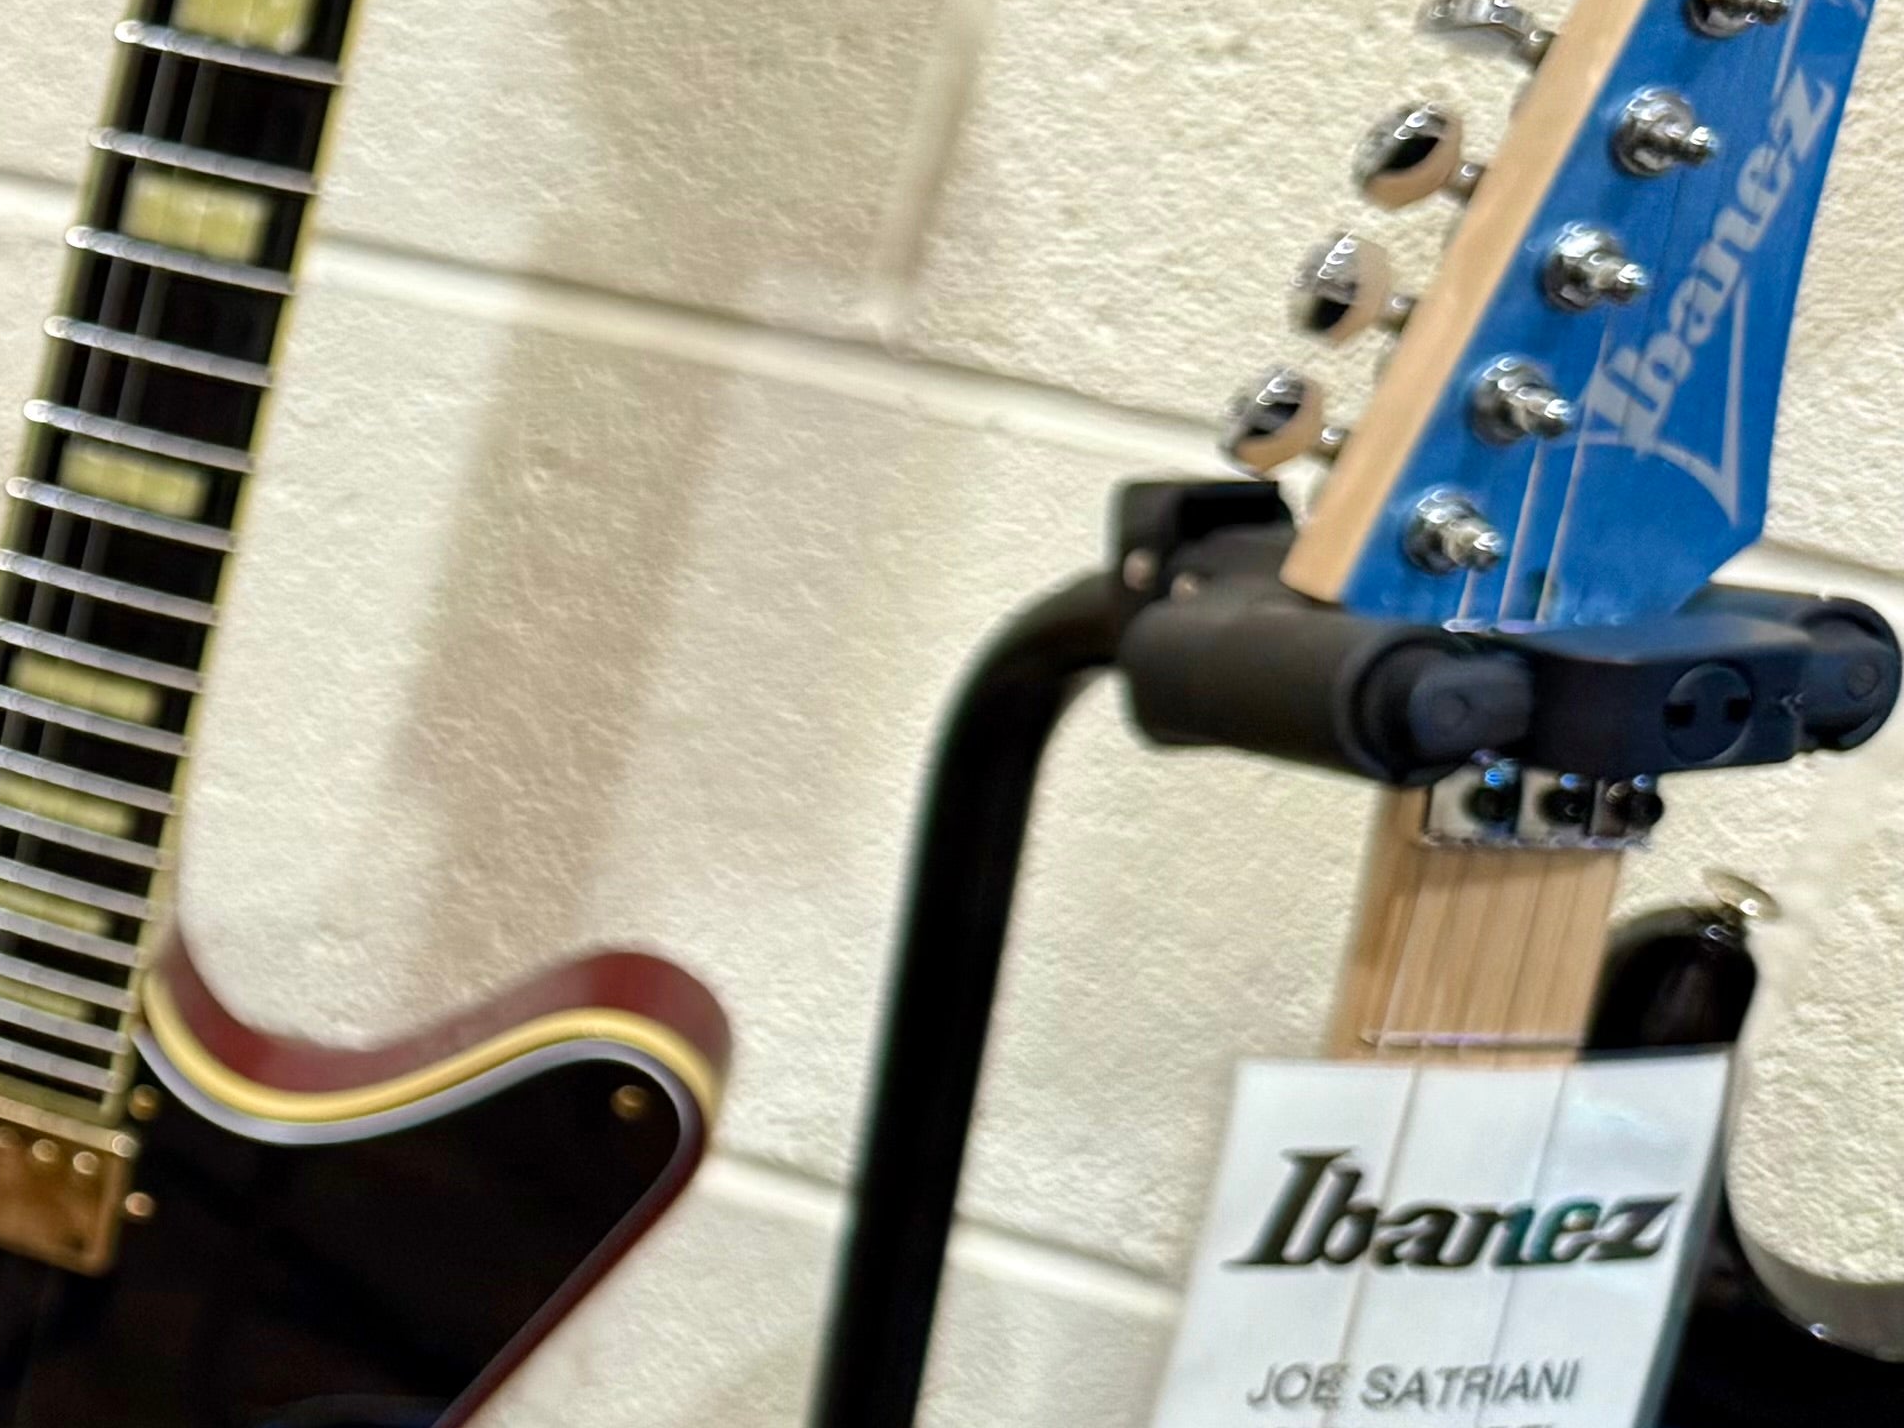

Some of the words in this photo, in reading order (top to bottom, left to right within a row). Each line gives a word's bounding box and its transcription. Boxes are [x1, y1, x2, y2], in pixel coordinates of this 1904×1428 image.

[1586, 64, 1837, 461] Ibanez
[1220, 1145, 1683, 1270] Ibanez
[1245, 1362, 1350, 1409] JOE
[1358, 1358, 1582, 1410] SATRIANI
